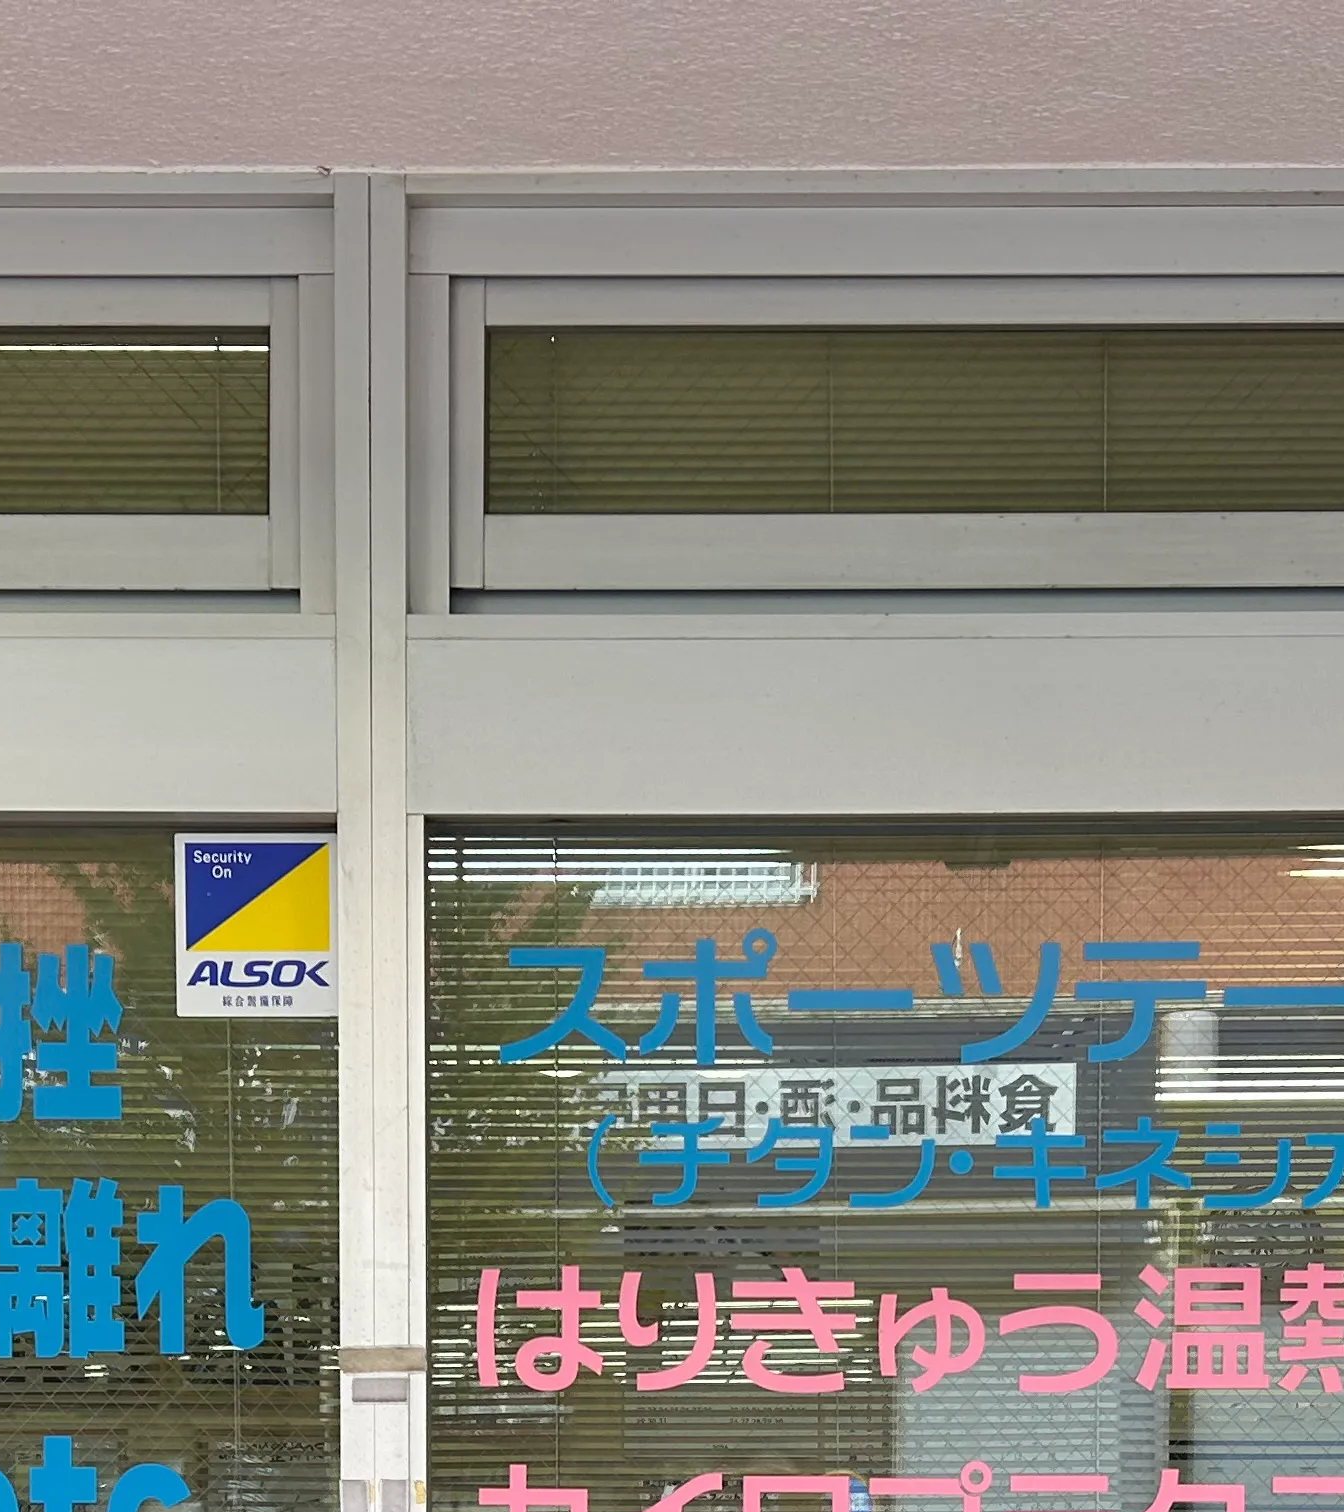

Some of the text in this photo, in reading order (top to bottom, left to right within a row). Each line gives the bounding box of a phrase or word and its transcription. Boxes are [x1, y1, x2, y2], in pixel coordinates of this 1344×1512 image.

[193, 850, 252, 864] Security
[212, 865, 232, 878] On
[186, 960, 330, 987] ALSOK
